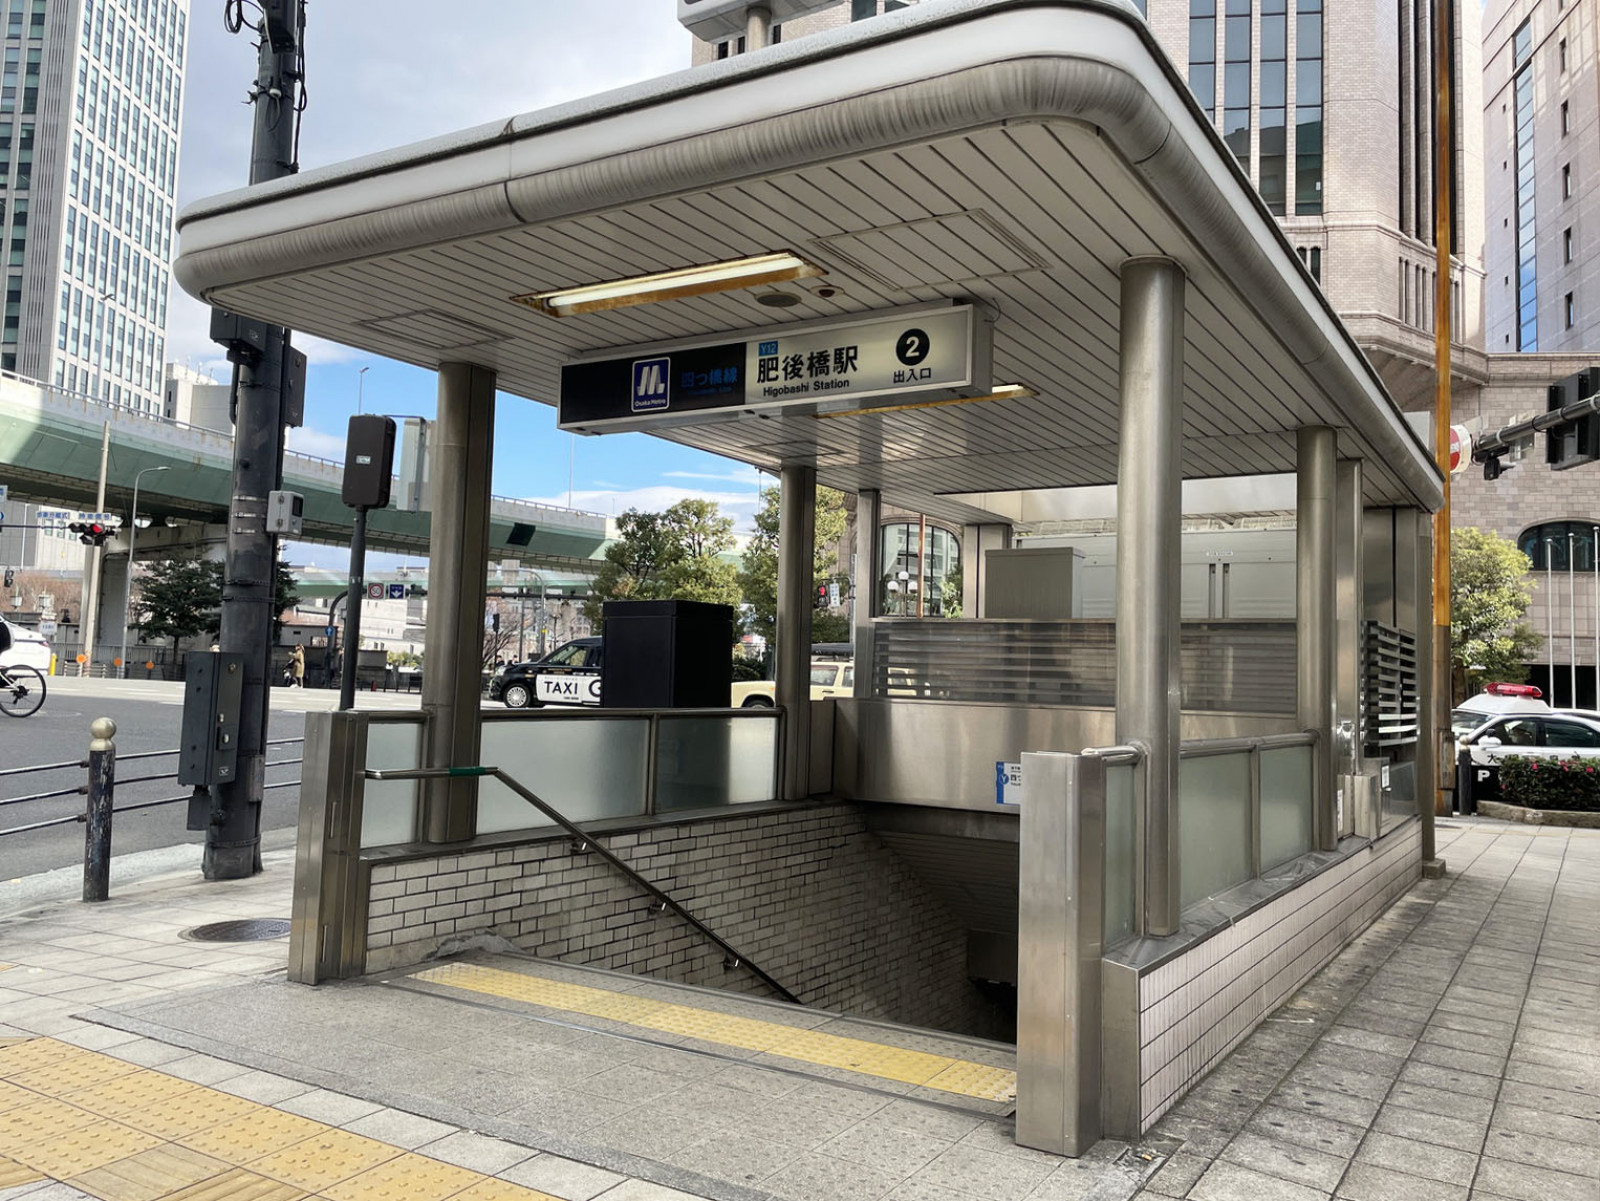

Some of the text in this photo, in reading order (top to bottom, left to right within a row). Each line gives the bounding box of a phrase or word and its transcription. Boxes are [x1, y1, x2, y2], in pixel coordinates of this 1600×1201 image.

[760, 342, 777, 355] Y12
[905, 336, 920, 358] 2
[757, 345, 859, 384] 肥後橋駅
[893, 368, 932, 384] 出入口
[763, 378, 850, 398] Higobashi Station
[544, 681, 578, 695] TAXI
